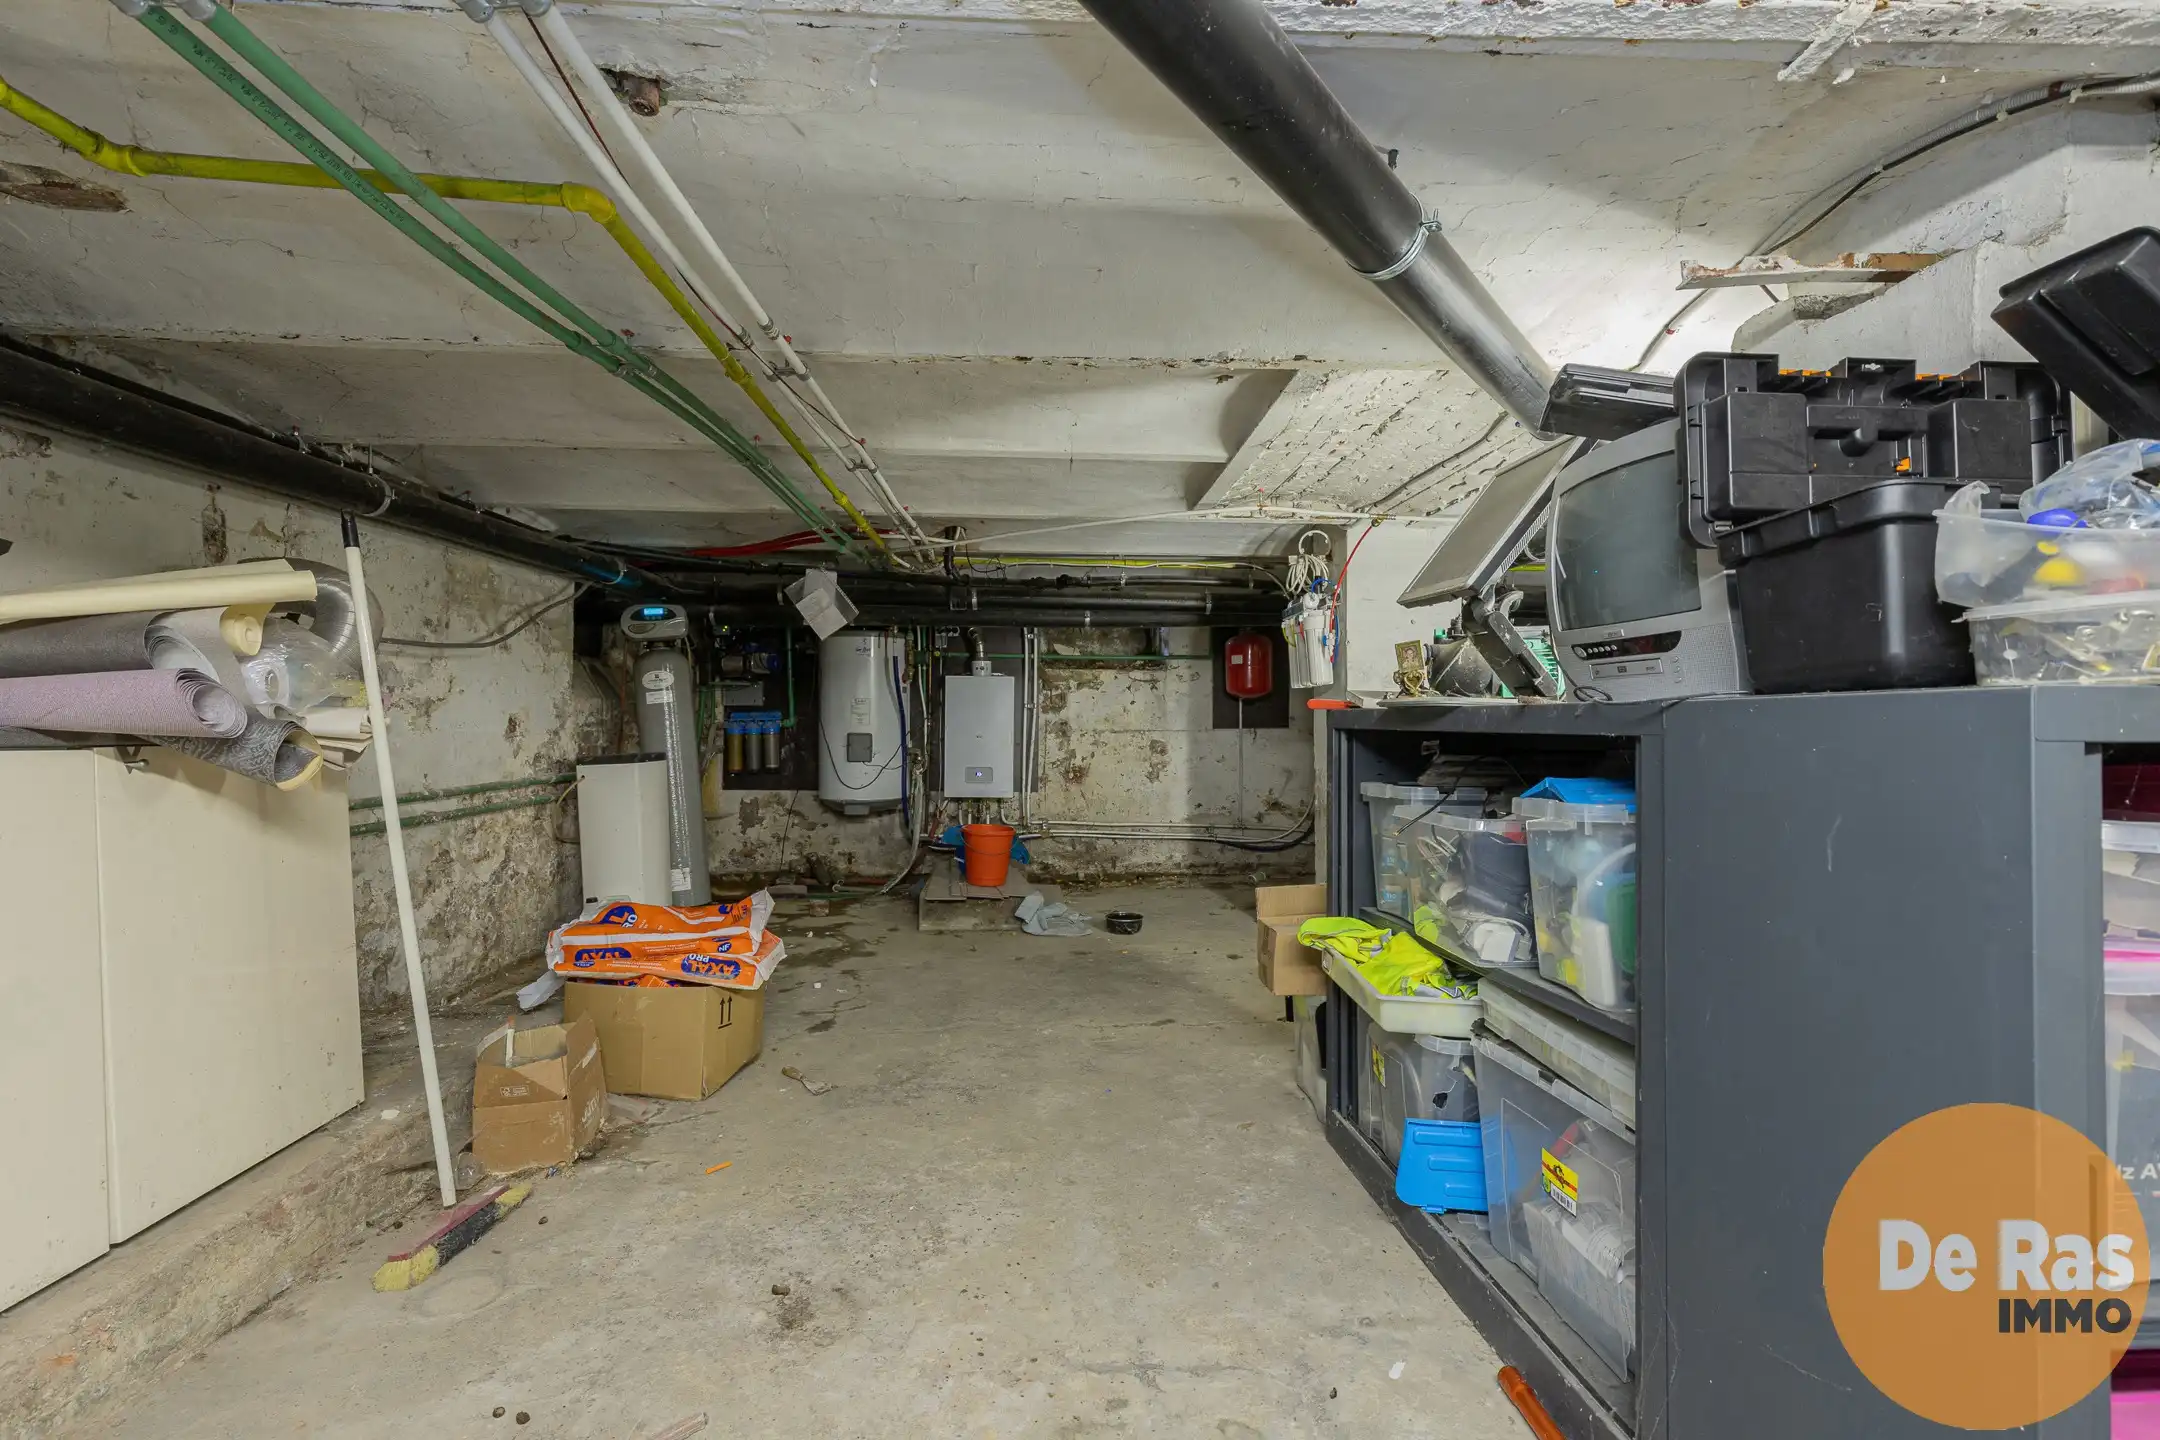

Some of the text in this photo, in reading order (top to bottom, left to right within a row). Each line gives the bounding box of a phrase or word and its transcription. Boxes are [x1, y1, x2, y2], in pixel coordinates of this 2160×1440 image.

[718, 943, 731, 952] NF
[688, 953, 710, 963] PRO
[688, 958, 736, 976] AXAL
